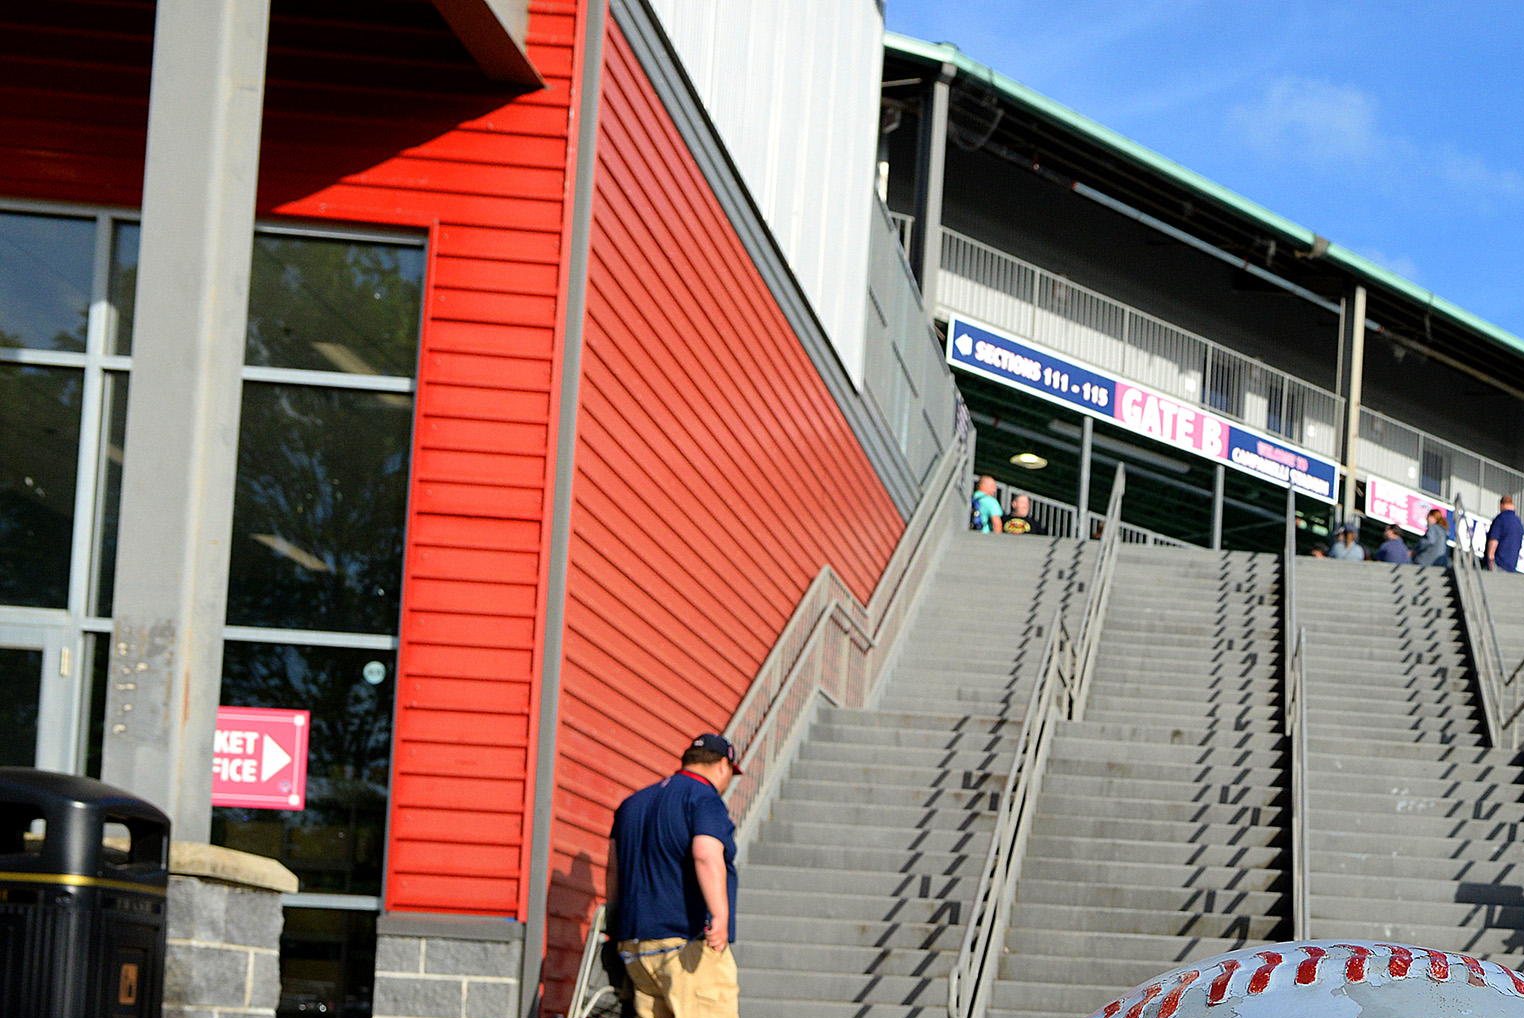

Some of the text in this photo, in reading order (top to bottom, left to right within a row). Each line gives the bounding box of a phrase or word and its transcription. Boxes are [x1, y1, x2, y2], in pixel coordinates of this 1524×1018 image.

[975, 341, 1041, 382] SECTIONS
[1043, 367, 1069, 393] 111
[1082, 382, 1109, 407] 115
[1121, 388, 1223, 458] GATE B
[213, 730, 260, 755] KET
[212, 757, 258, 783] FICE
